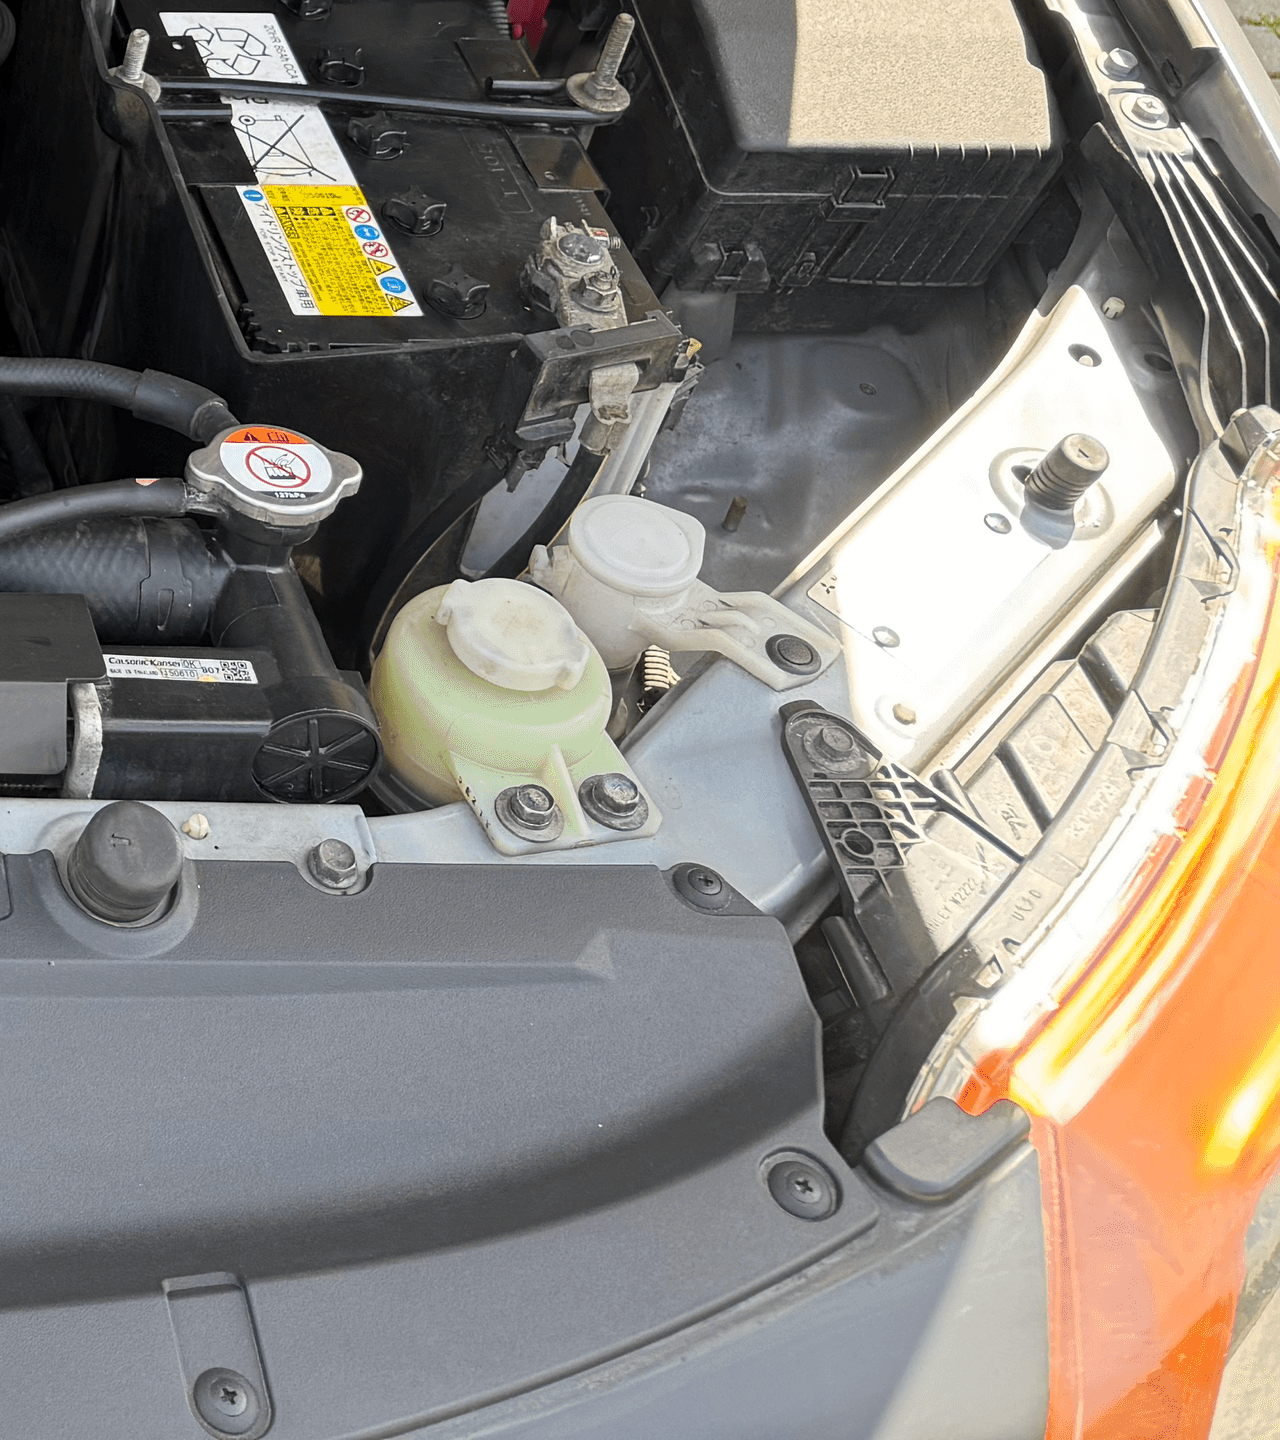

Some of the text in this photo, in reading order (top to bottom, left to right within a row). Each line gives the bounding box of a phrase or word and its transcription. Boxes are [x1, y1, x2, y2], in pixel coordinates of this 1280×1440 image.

[275, 265, 289, 283] START
[108, 657, 149, 666] Calsonic
[150, 659, 182, 668] Kansei
